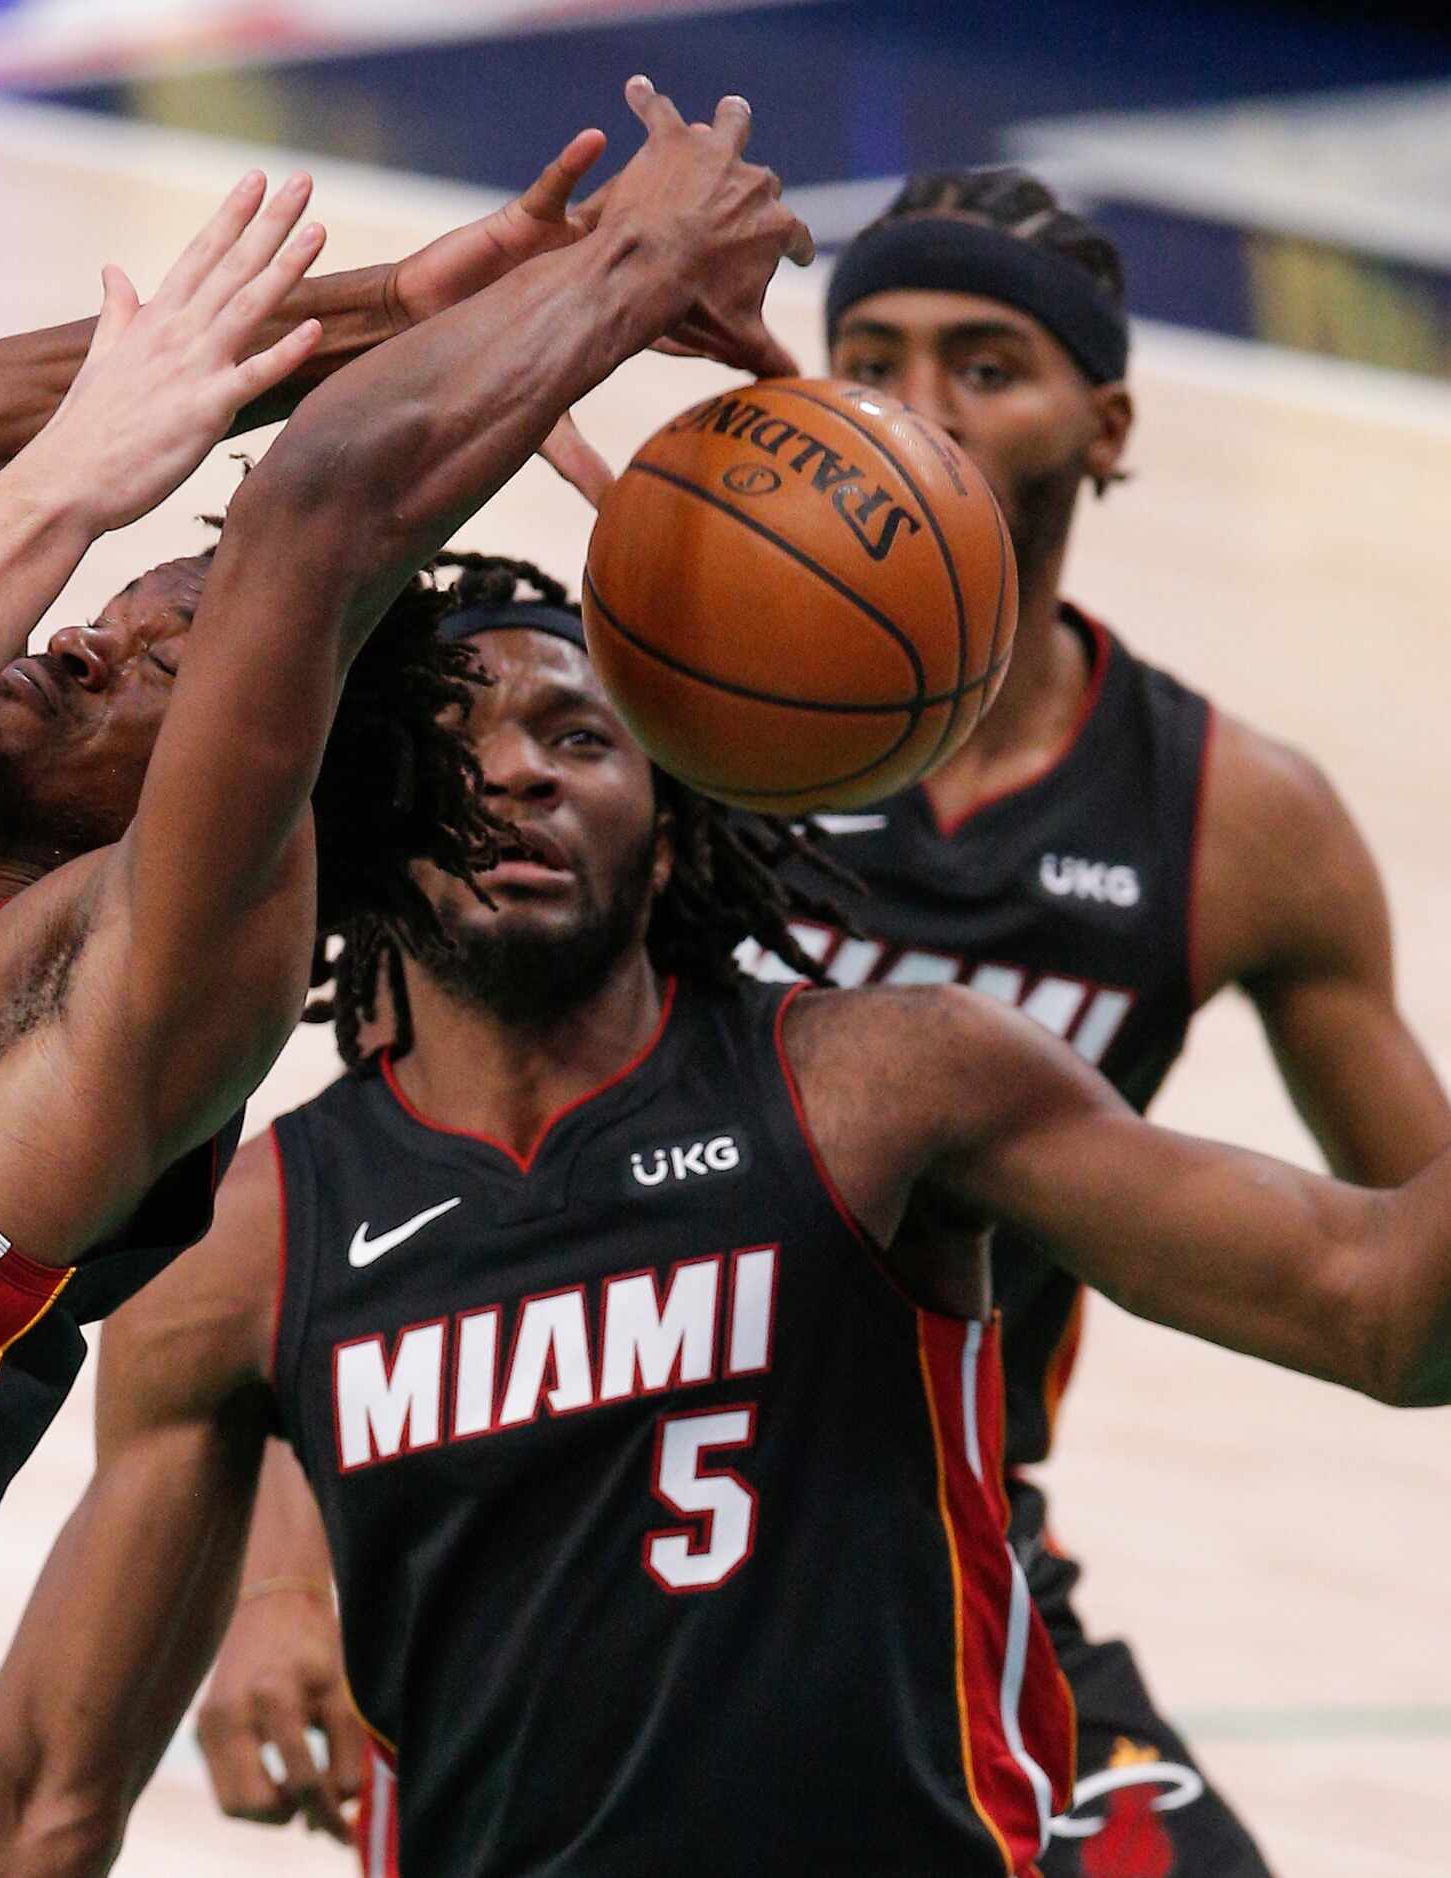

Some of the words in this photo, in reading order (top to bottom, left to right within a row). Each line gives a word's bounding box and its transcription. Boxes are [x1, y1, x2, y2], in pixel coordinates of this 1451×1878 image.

[670, 396, 921, 562] SPALDIN
[333, 1242, 780, 1474] MIAMI
[641, 1402, 758, 1594] 5
